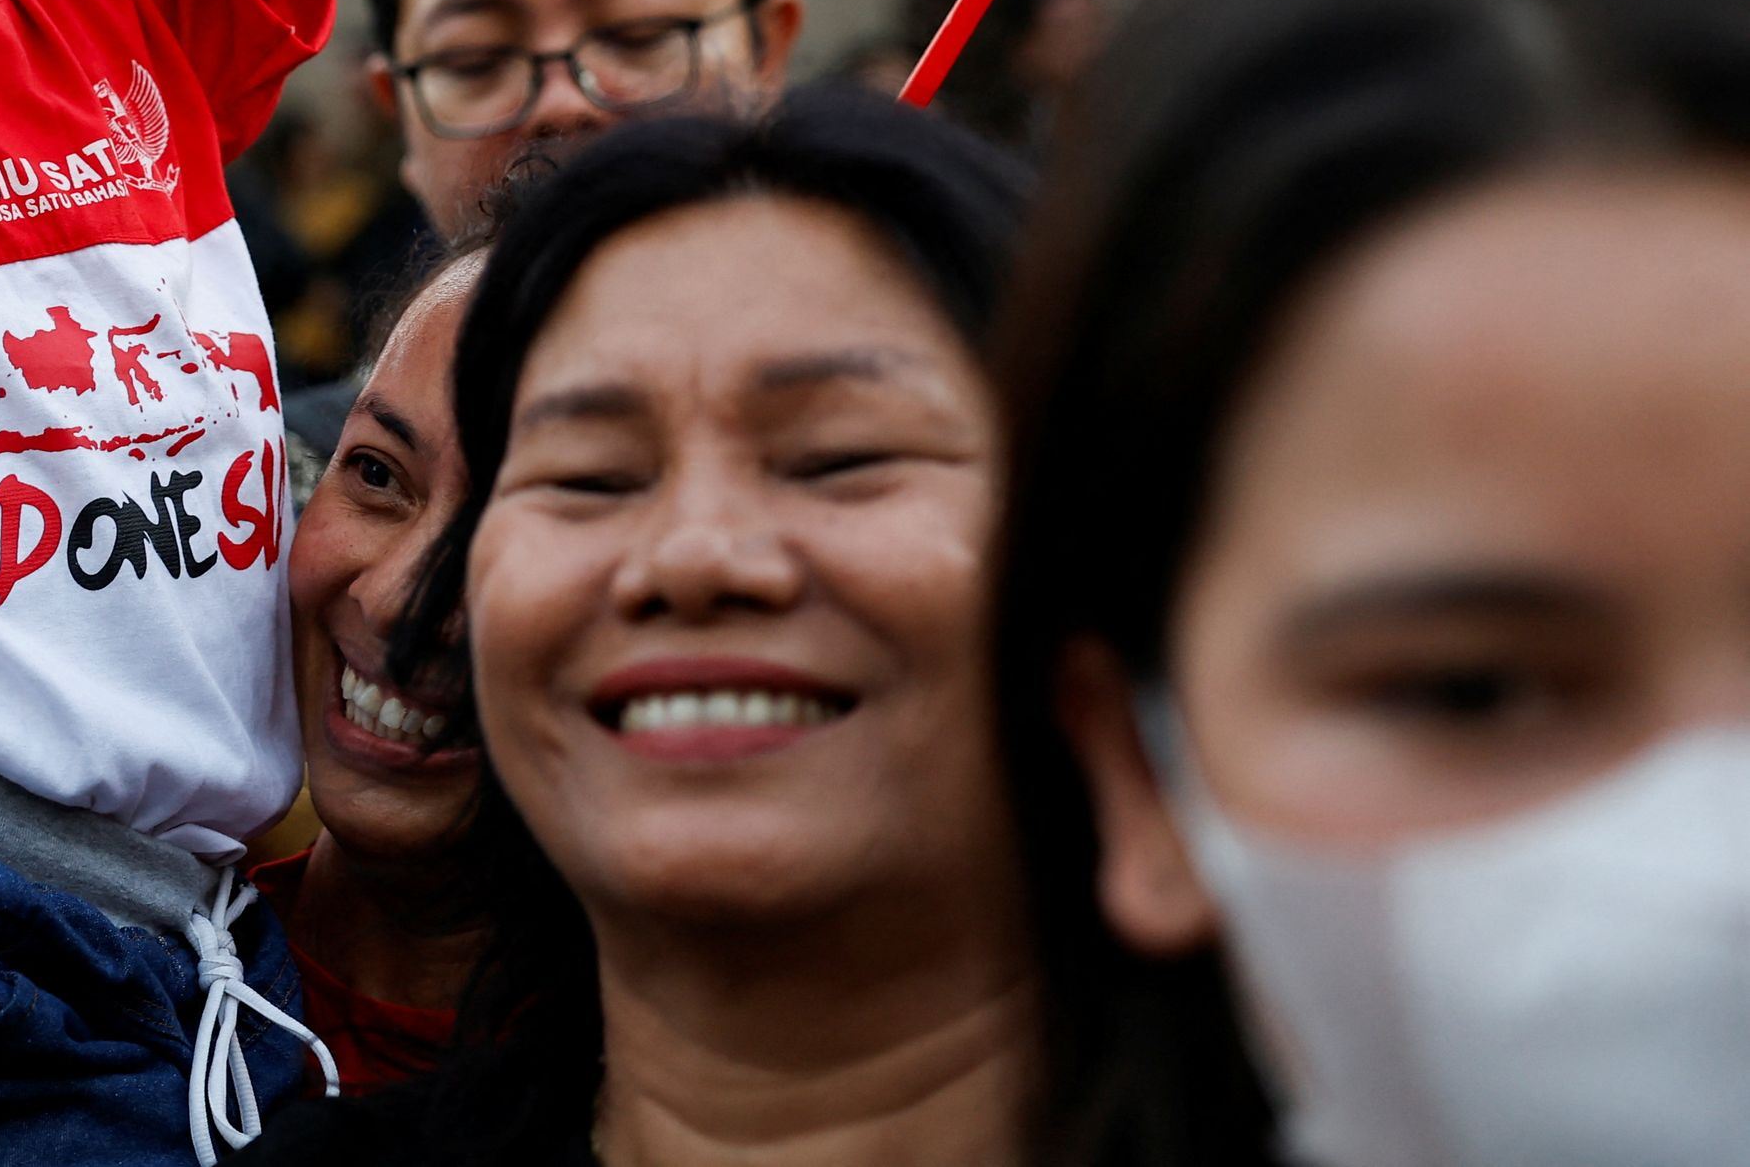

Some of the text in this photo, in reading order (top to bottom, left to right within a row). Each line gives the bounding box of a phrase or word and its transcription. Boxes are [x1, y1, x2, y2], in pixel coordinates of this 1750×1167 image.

[39, 137, 118, 192] SAT
[25, 192, 73, 218] SATU
[70, 177, 129, 207] BAHAS
